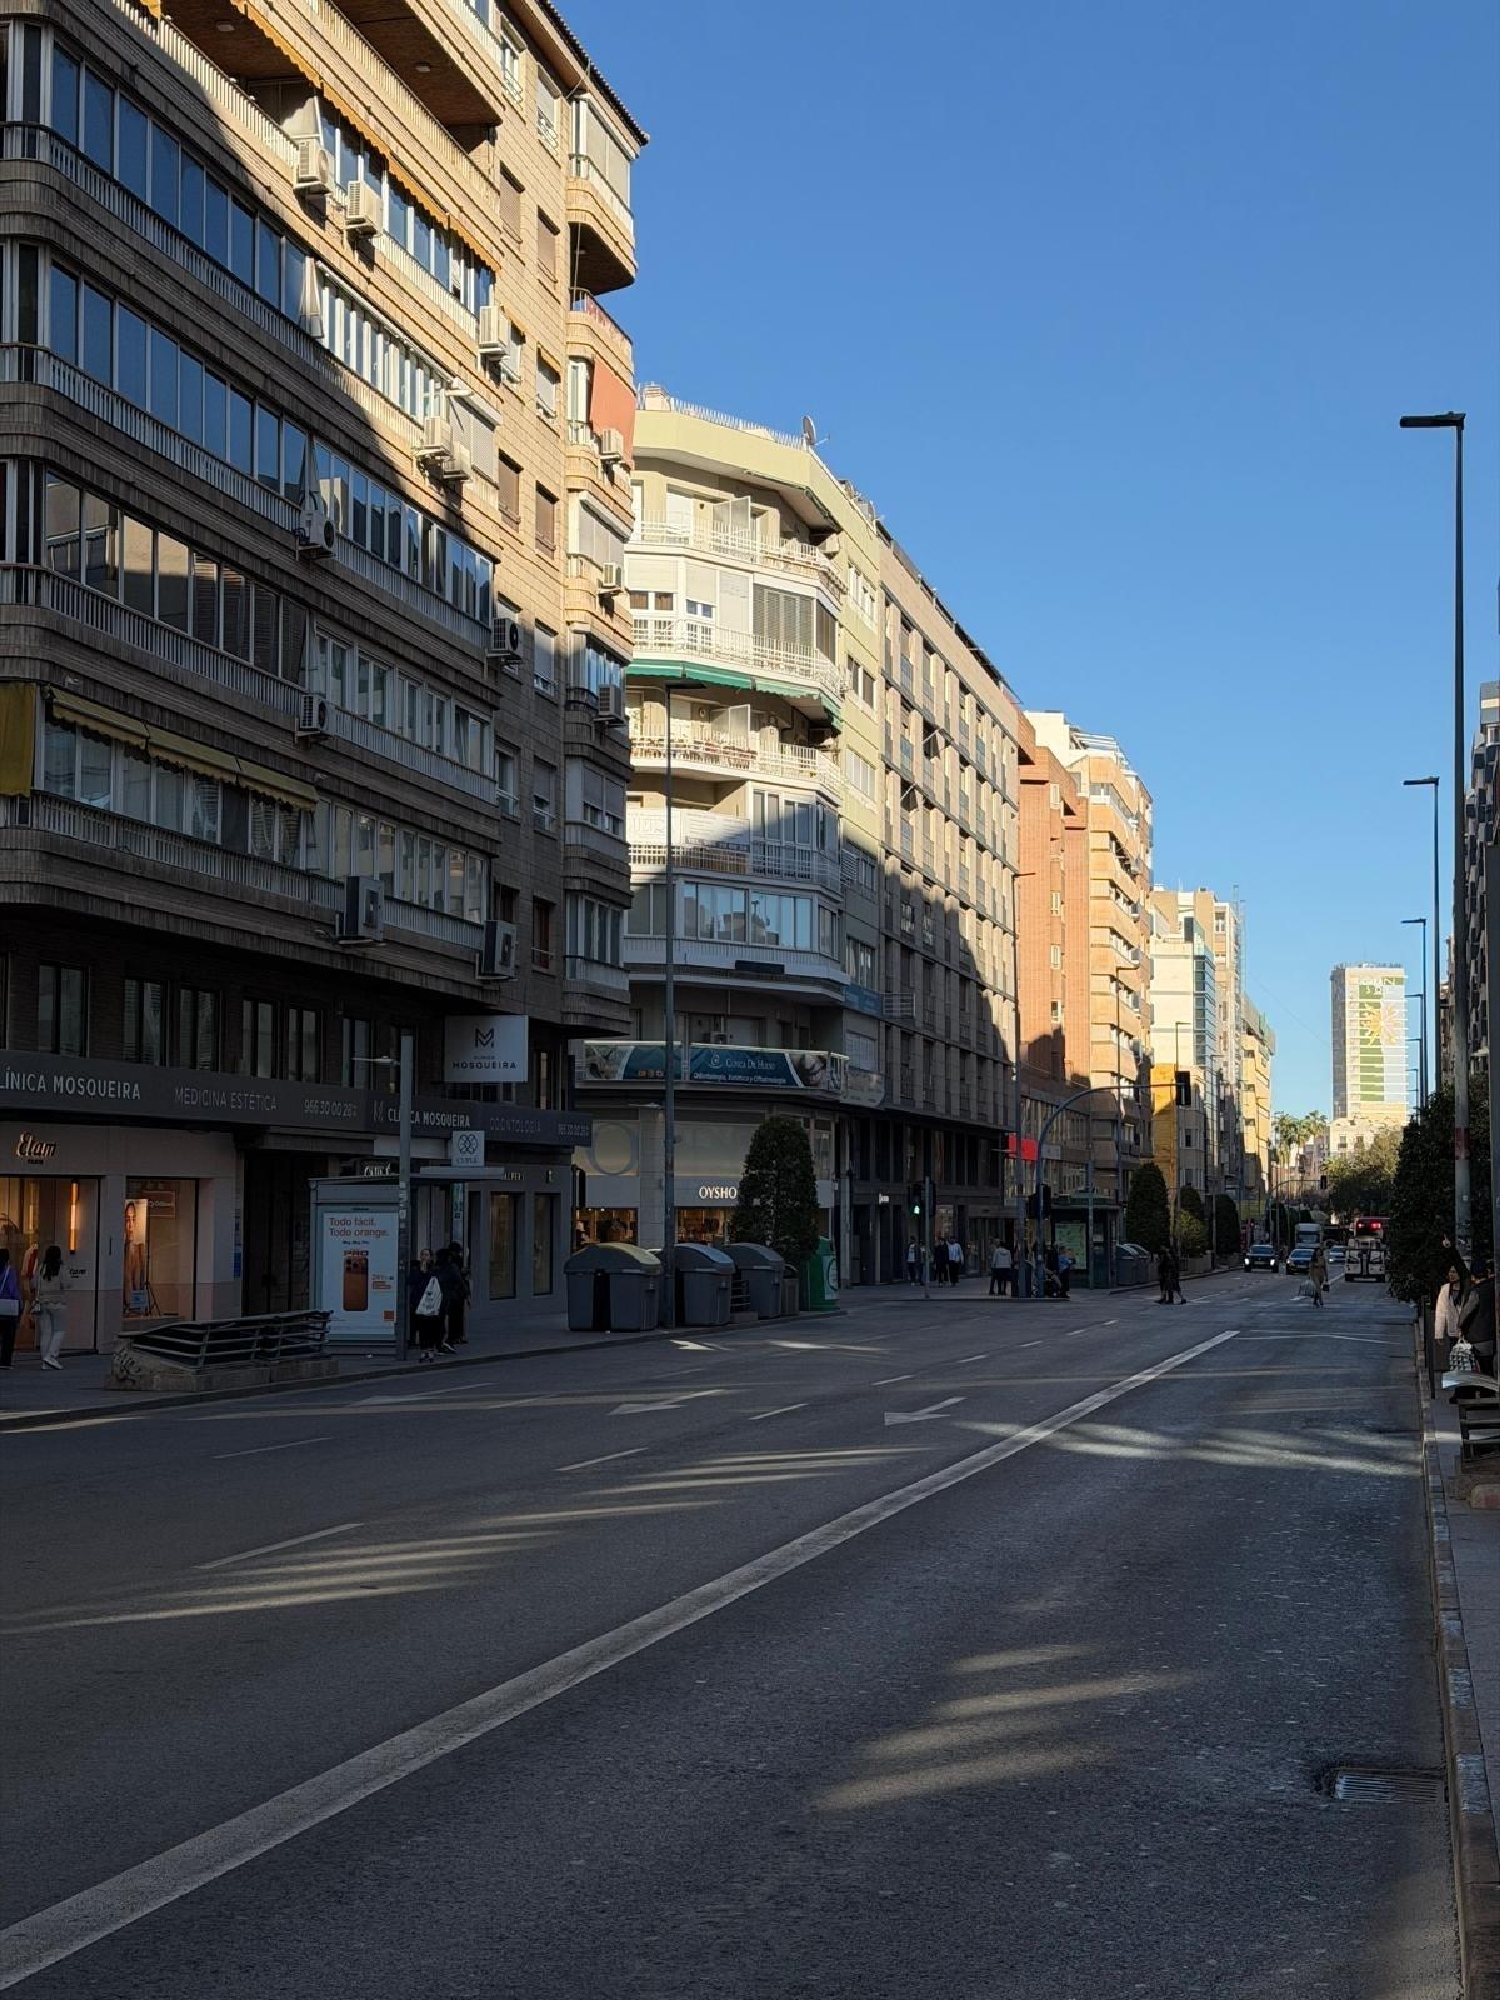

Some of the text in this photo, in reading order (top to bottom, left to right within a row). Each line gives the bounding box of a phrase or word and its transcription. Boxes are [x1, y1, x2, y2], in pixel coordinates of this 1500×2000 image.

[452, 1061, 517, 1070] MOSQUEIRA
[53, 1074, 141, 1101] MOSQUEIRA
[174, 1086, 227, 1106] MEDICINA
[423, 1111, 471, 1129] MOSQUEIRA
[16, 1132, 57, 1157] Etam
[698, 1185, 738, 1200] OYSHO
[328, 1217, 352, 1227] Todo
[328, 1227, 352, 1237] Todo
